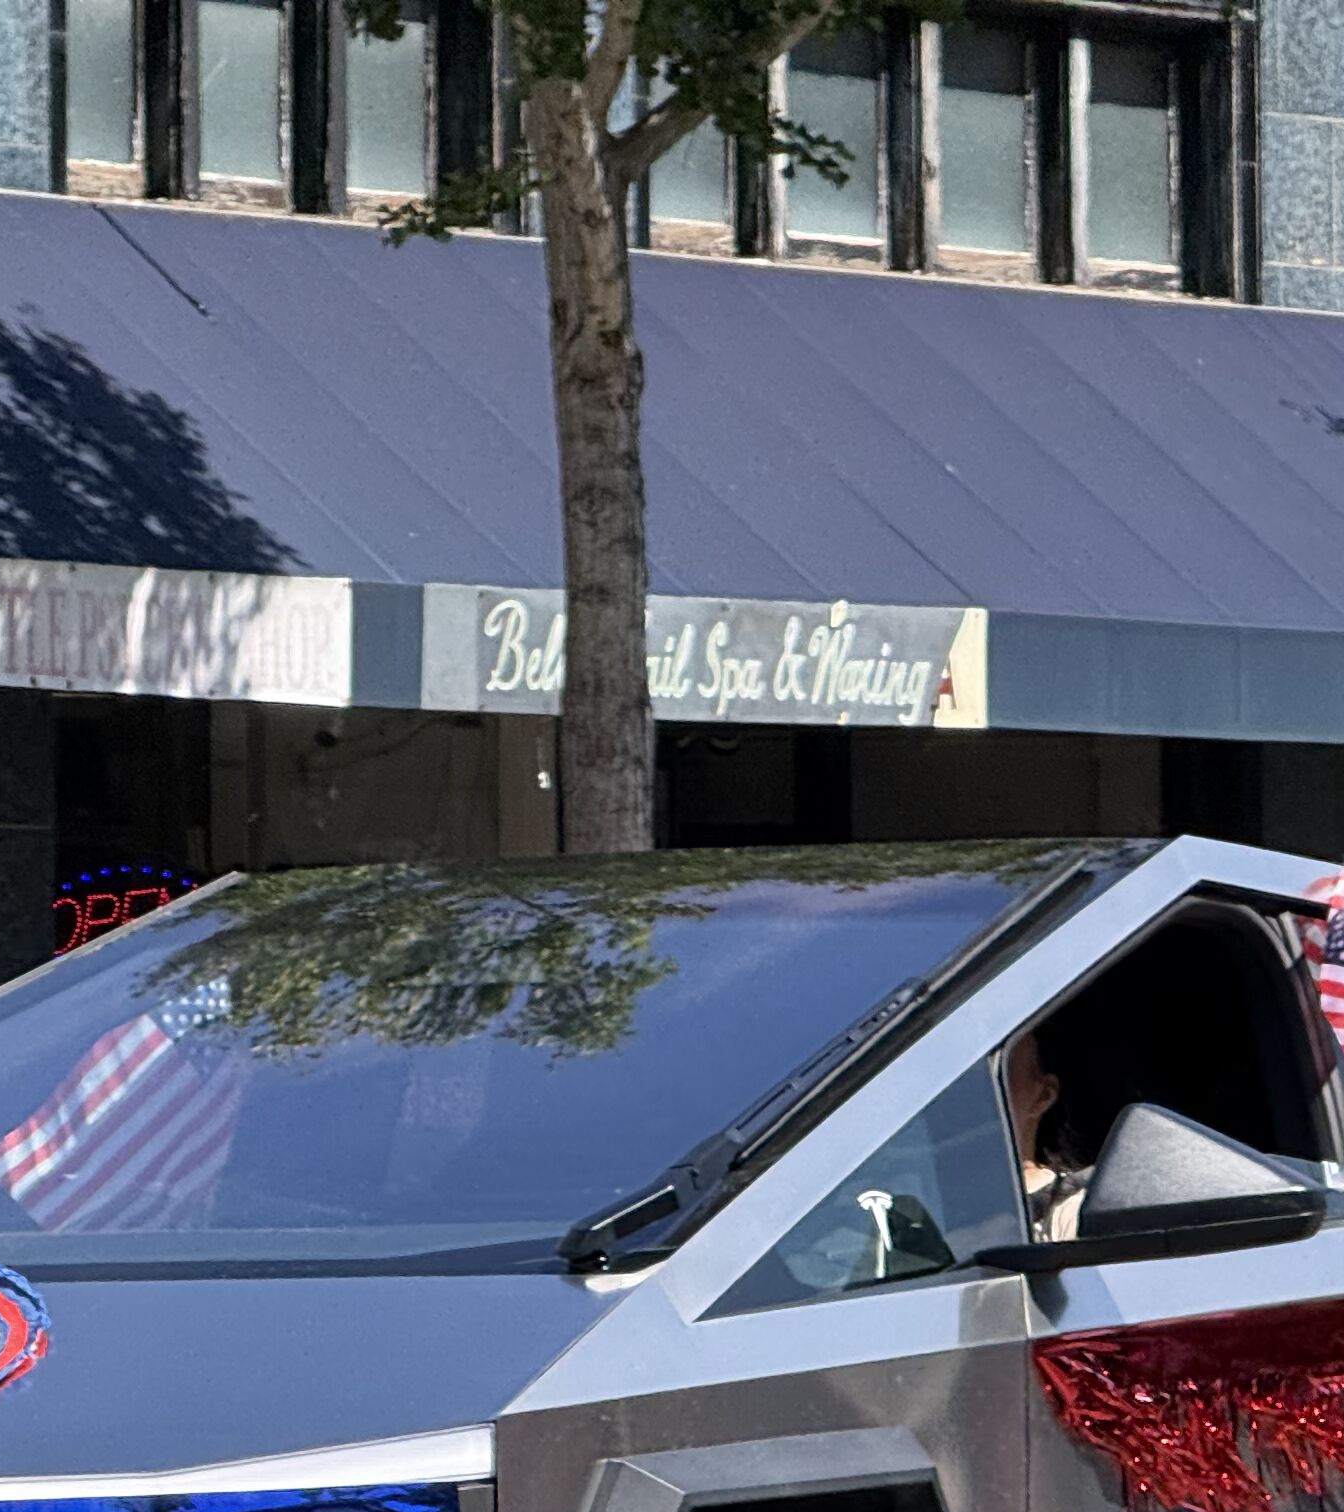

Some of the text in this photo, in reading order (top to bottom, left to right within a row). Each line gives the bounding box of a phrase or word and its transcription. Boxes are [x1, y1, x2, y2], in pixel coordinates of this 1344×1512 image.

[697, 620, 767, 716] Spa
[772, 615, 806, 701] &
[807, 622, 932, 726] Waxing
